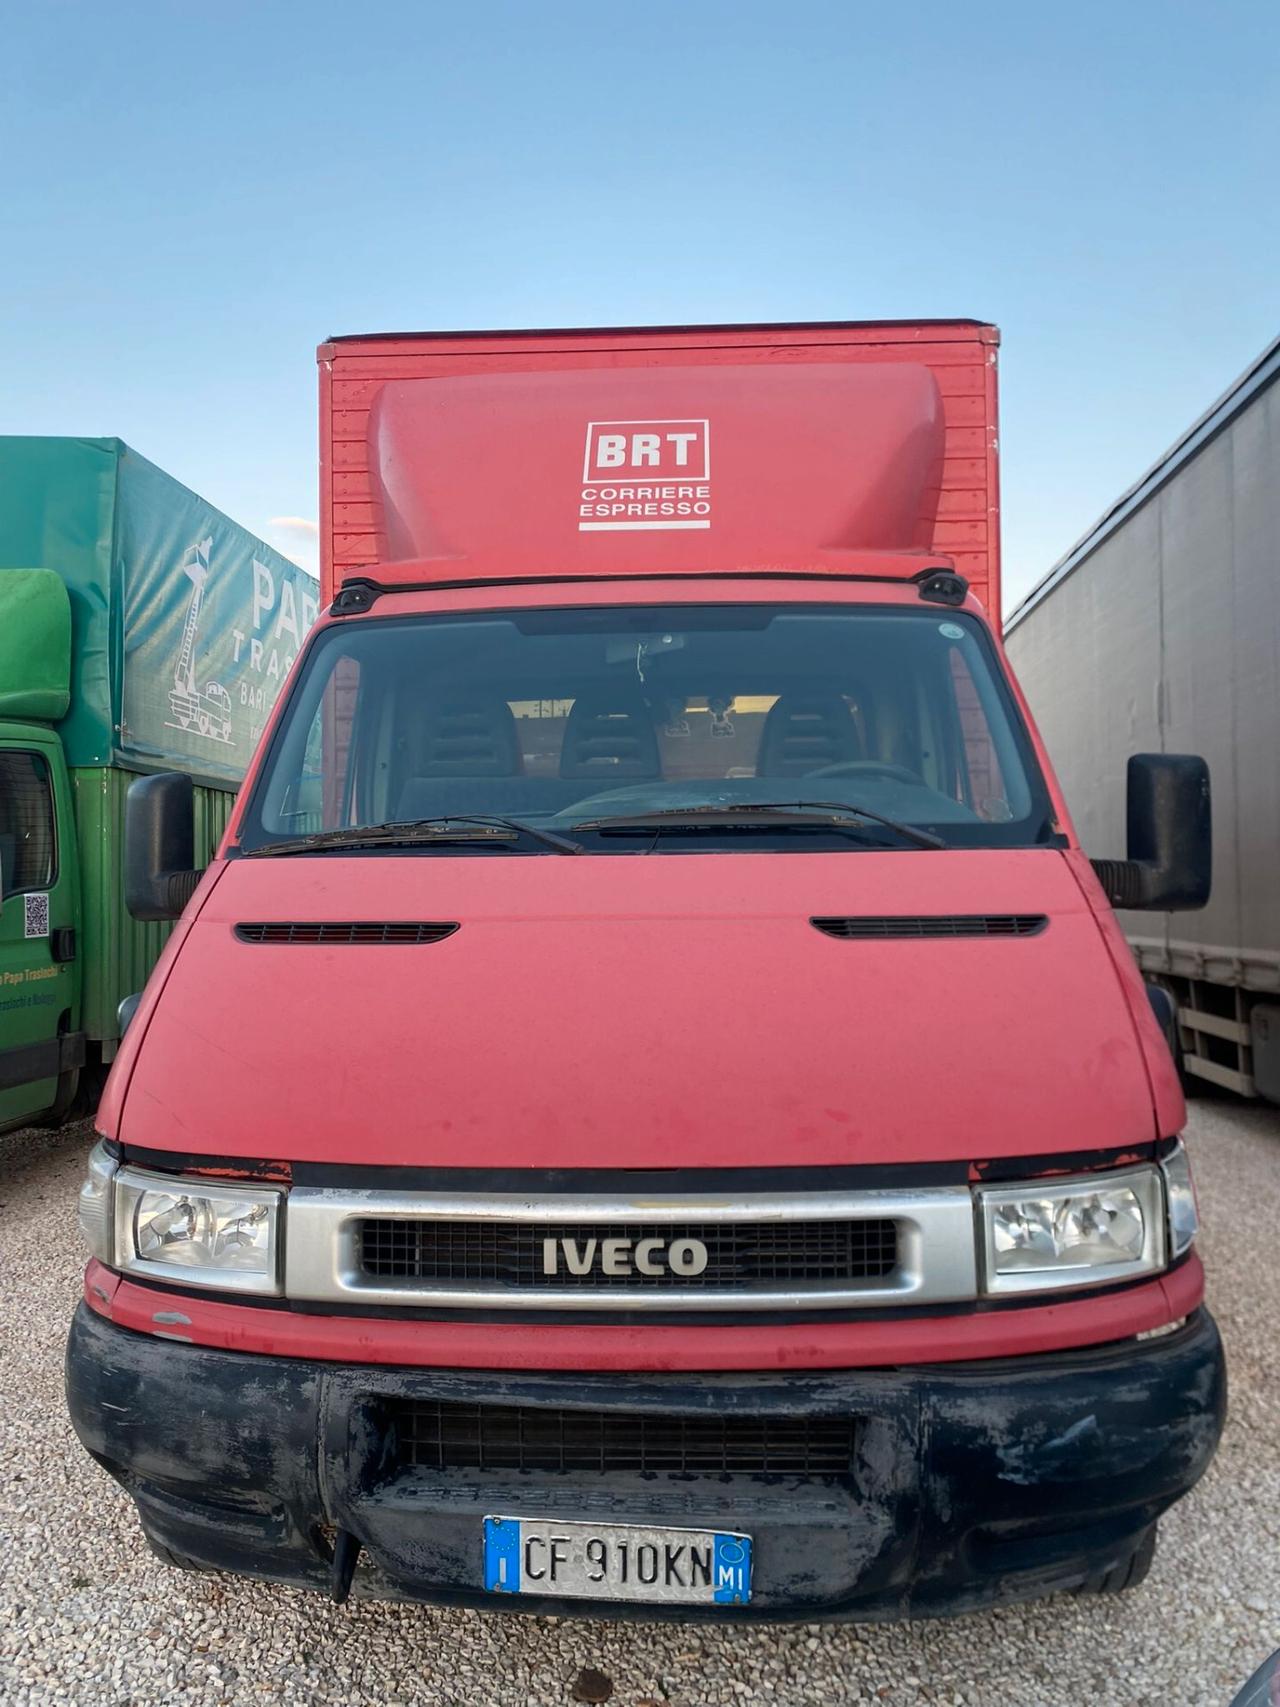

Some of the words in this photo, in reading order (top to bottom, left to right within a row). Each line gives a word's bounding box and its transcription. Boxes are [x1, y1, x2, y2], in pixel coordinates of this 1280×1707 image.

[596, 433, 697, 467] BRT
[579, 501, 711, 517] ESPRESSO
[581, 486, 711, 500] CORRIERE
[252, 559, 320, 651] PAP
[240, 681, 266, 713] BARI
[543, 1238, 708, 1276] IVECO
[524, 1534, 571, 1581] CF
[586, 1538, 712, 1587] 910KN
[718, 1566, 744, 1590] MI
